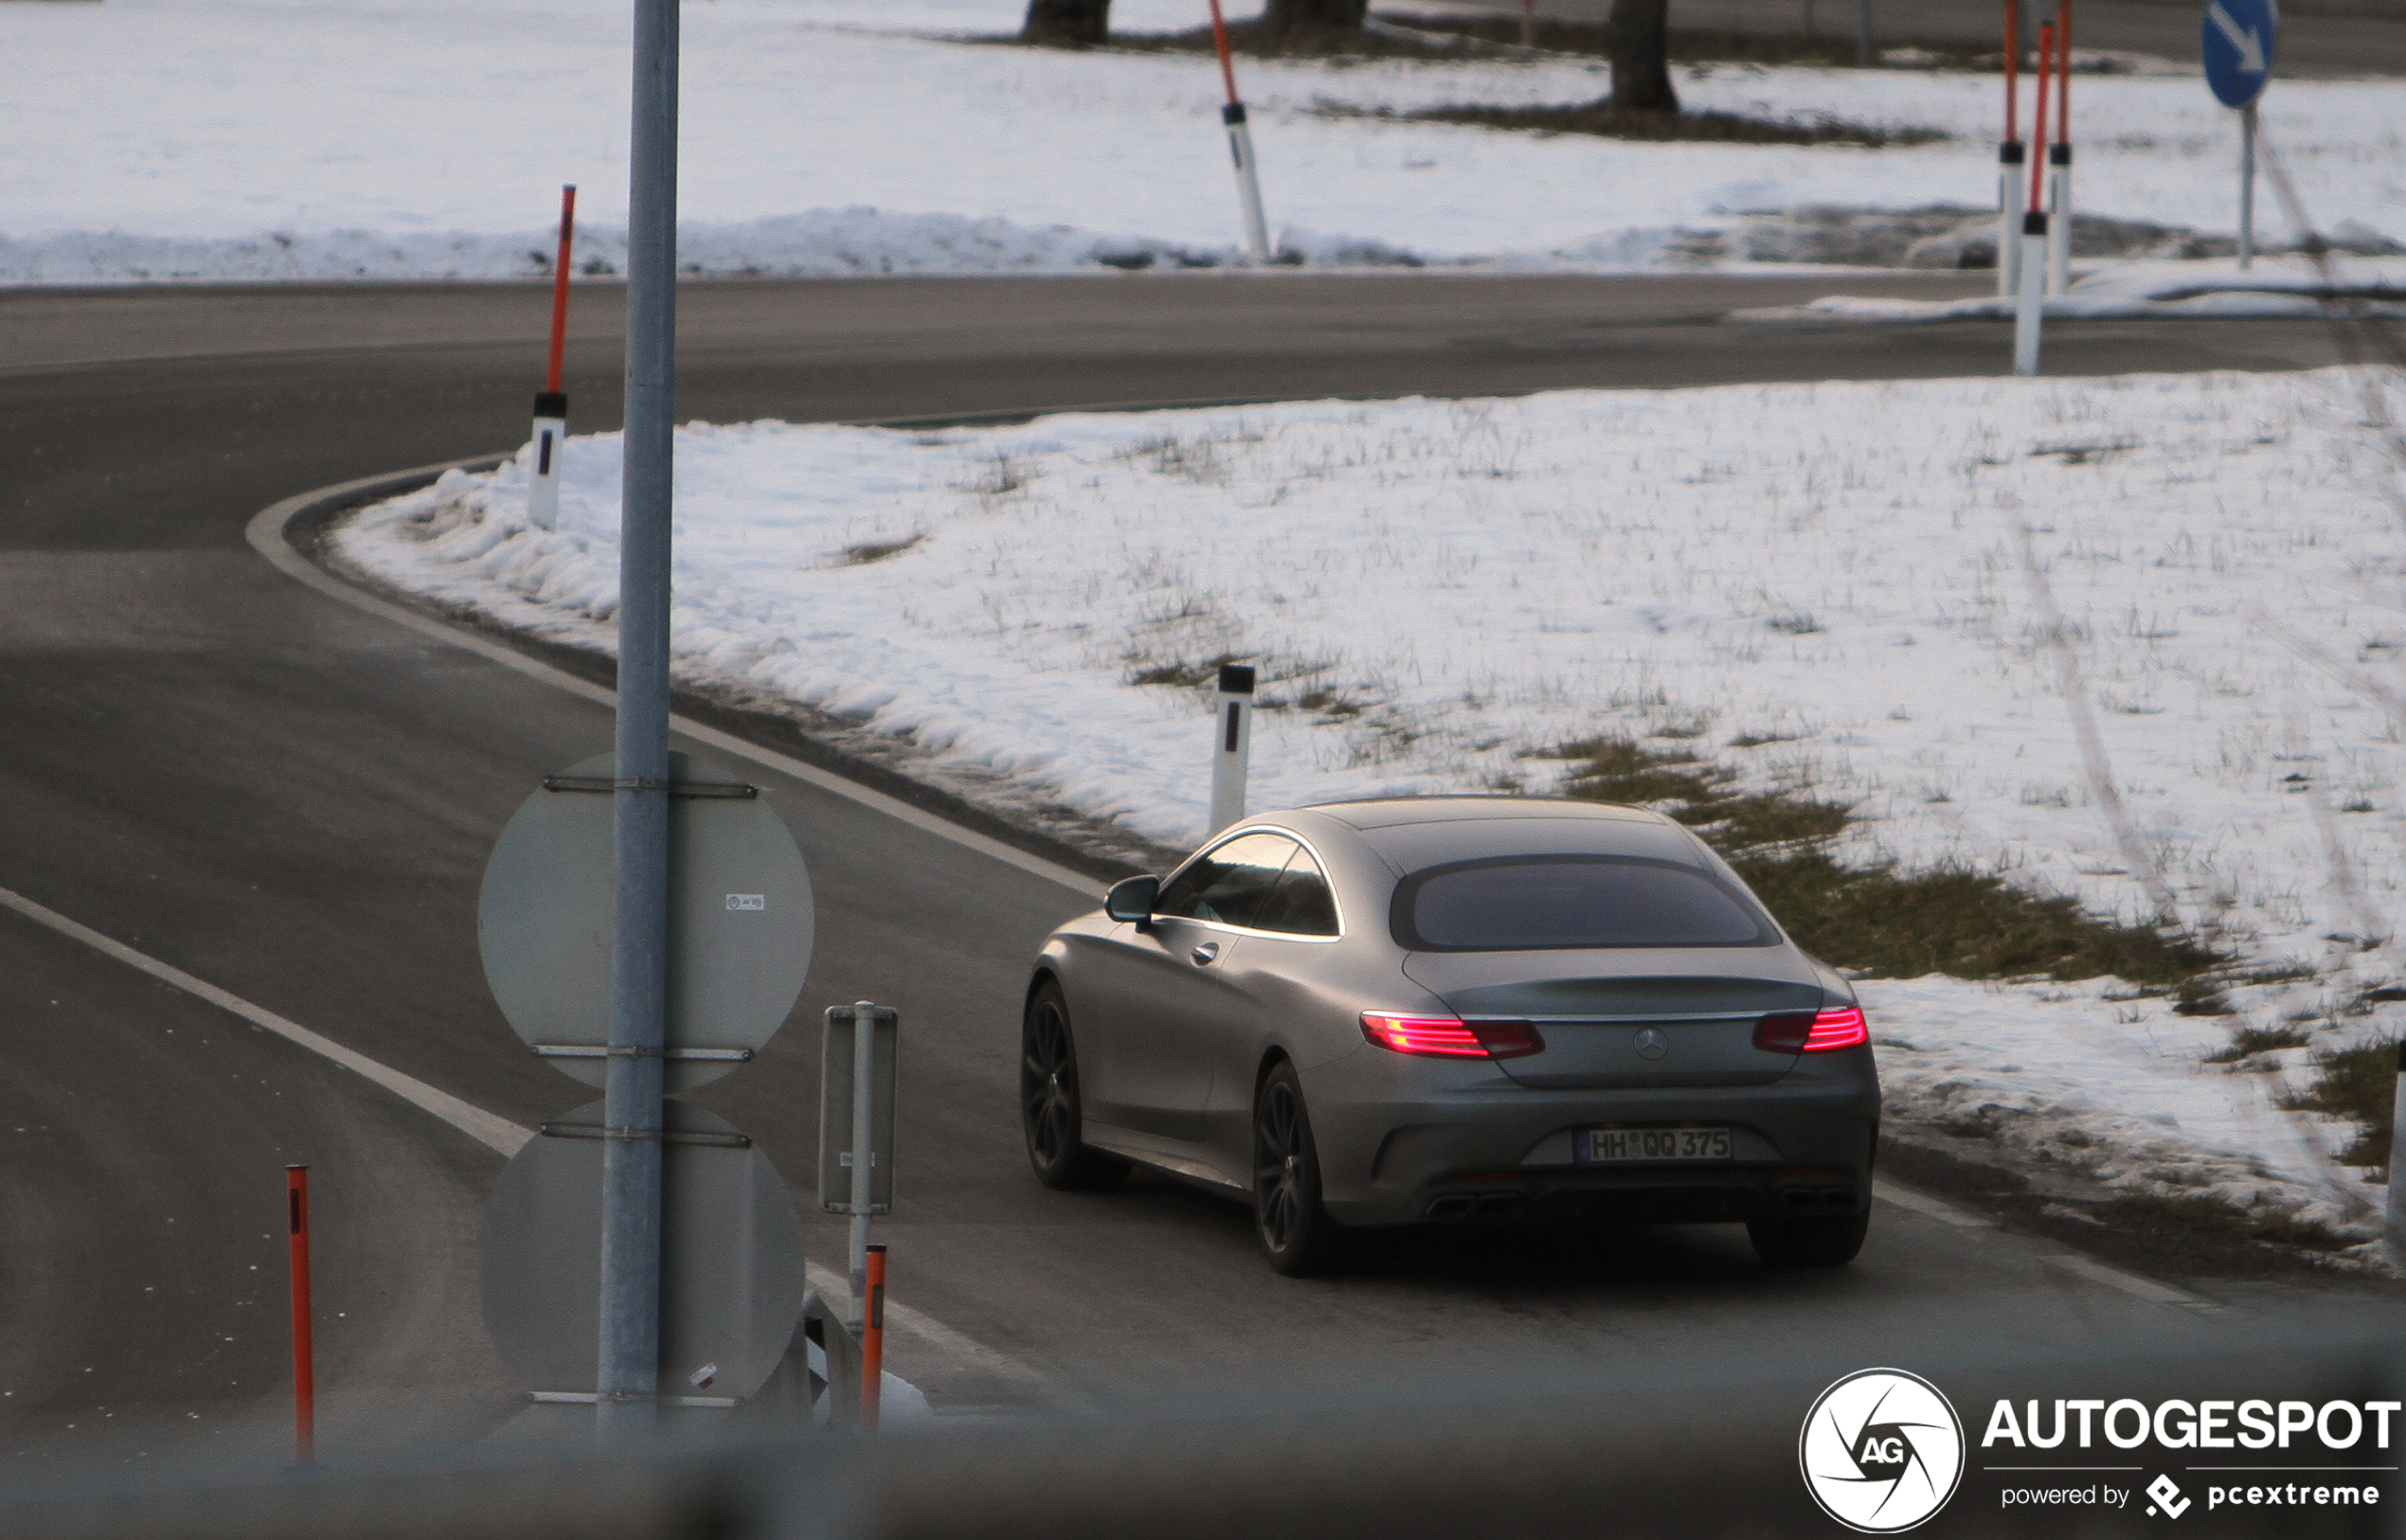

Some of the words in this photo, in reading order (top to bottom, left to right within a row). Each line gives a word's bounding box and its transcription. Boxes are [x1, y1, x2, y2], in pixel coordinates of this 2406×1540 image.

[1592, 1134, 1626, 1158] HH
[1643, 1131, 1677, 1156] QQ
[1681, 1131, 1728, 1156] 375
